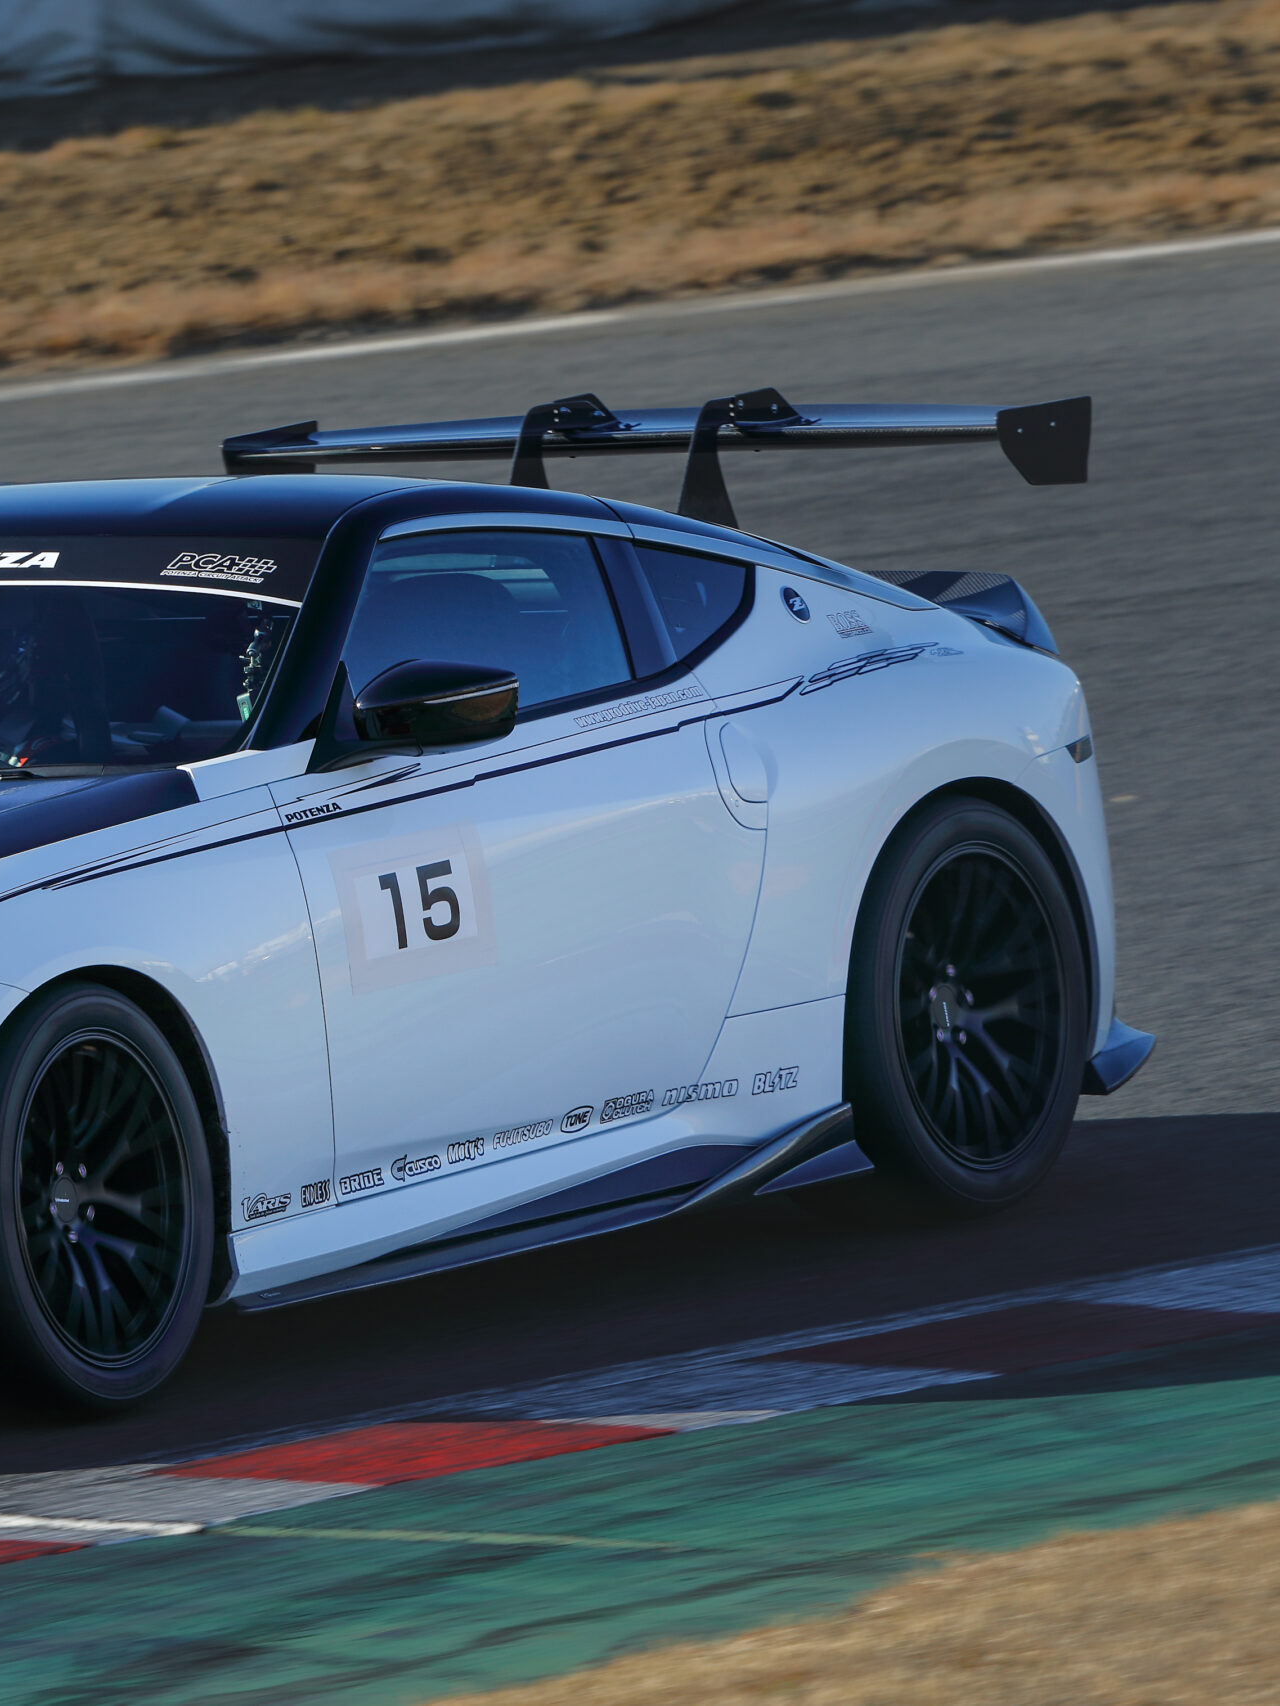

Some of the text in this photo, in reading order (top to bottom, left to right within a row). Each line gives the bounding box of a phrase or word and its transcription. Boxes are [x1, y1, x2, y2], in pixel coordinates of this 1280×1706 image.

[160, 569, 199, 577] POTENZA
[573, 685, 703, 729] www.prodrive-japan.com
[284, 801, 342, 823] POTENZA
[378, 859, 461, 950] 15
[616, 1089, 655, 1108] OGURA
[613, 1101, 652, 1120] CLUTCH
[300, 1179, 331, 1208] ENDLESS
[339, 1168, 385, 1195] BRIDE
[447, 1137, 485, 1165] Moty's
[492, 1119, 554, 1150] FUJITSUBO
[565, 1111, 592, 1127] TONE
